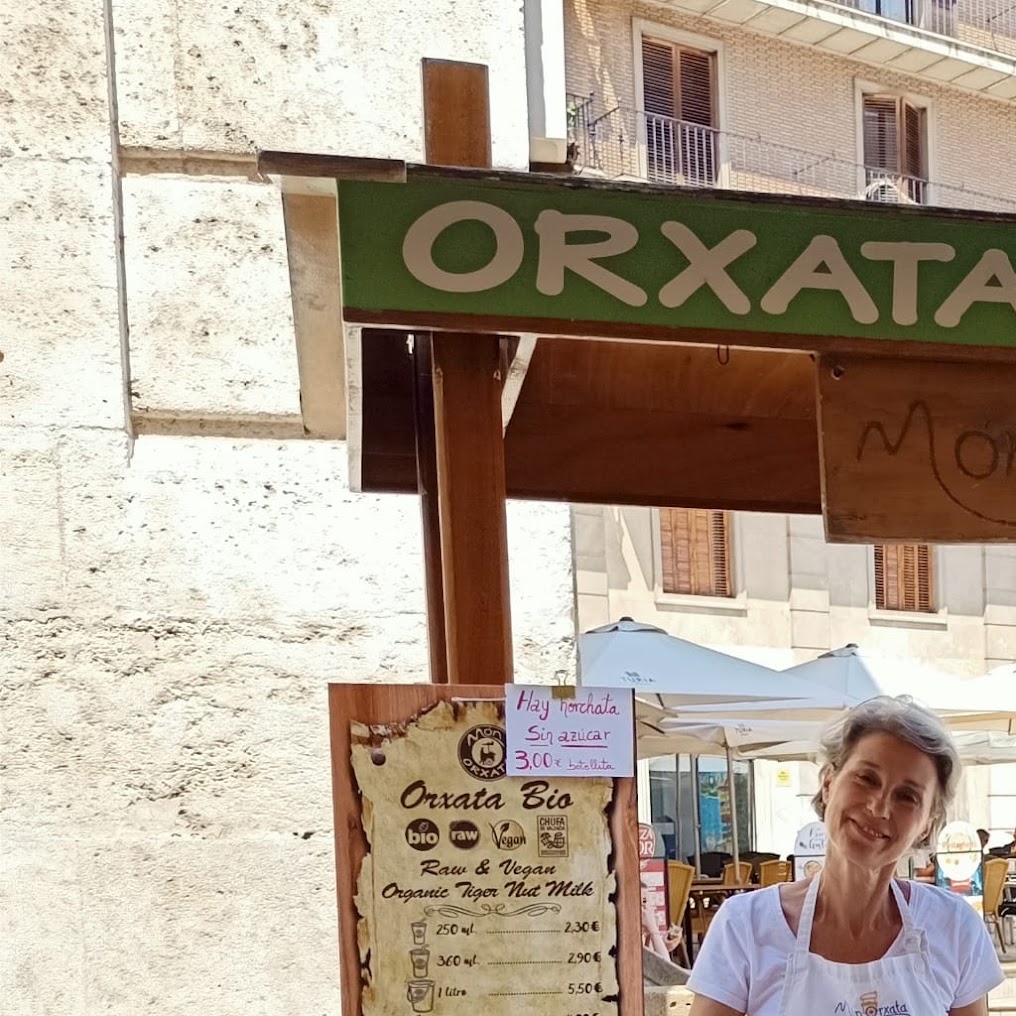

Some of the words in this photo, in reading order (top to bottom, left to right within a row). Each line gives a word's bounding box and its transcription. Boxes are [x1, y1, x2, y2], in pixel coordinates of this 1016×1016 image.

[517, 690, 549, 720] Hay
[525, 726, 553, 744] Sin
[462, 757, 507, 778] ORXAT
[400, 780, 505, 811] Orxata
[520, 780, 574, 810] Bio
[539, 817, 566, 828] CHUFA
[408, 828, 439, 845] bio
[450, 829, 479, 842] raw
[489, 822, 527, 849] Vegan
[420, 858, 468, 877] Raw
[475, 858, 490, 875] &
[499, 858, 557, 880] Vegan
[381, 882, 450, 904] Organic
[455, 881, 500, 903] Tiger
[503, 880, 542, 898] Nut
[545, 880, 595, 897] Milk
[436, 923, 459, 936] 250
[436, 955, 461, 967] 360
[445, 986, 467, 997] litro
